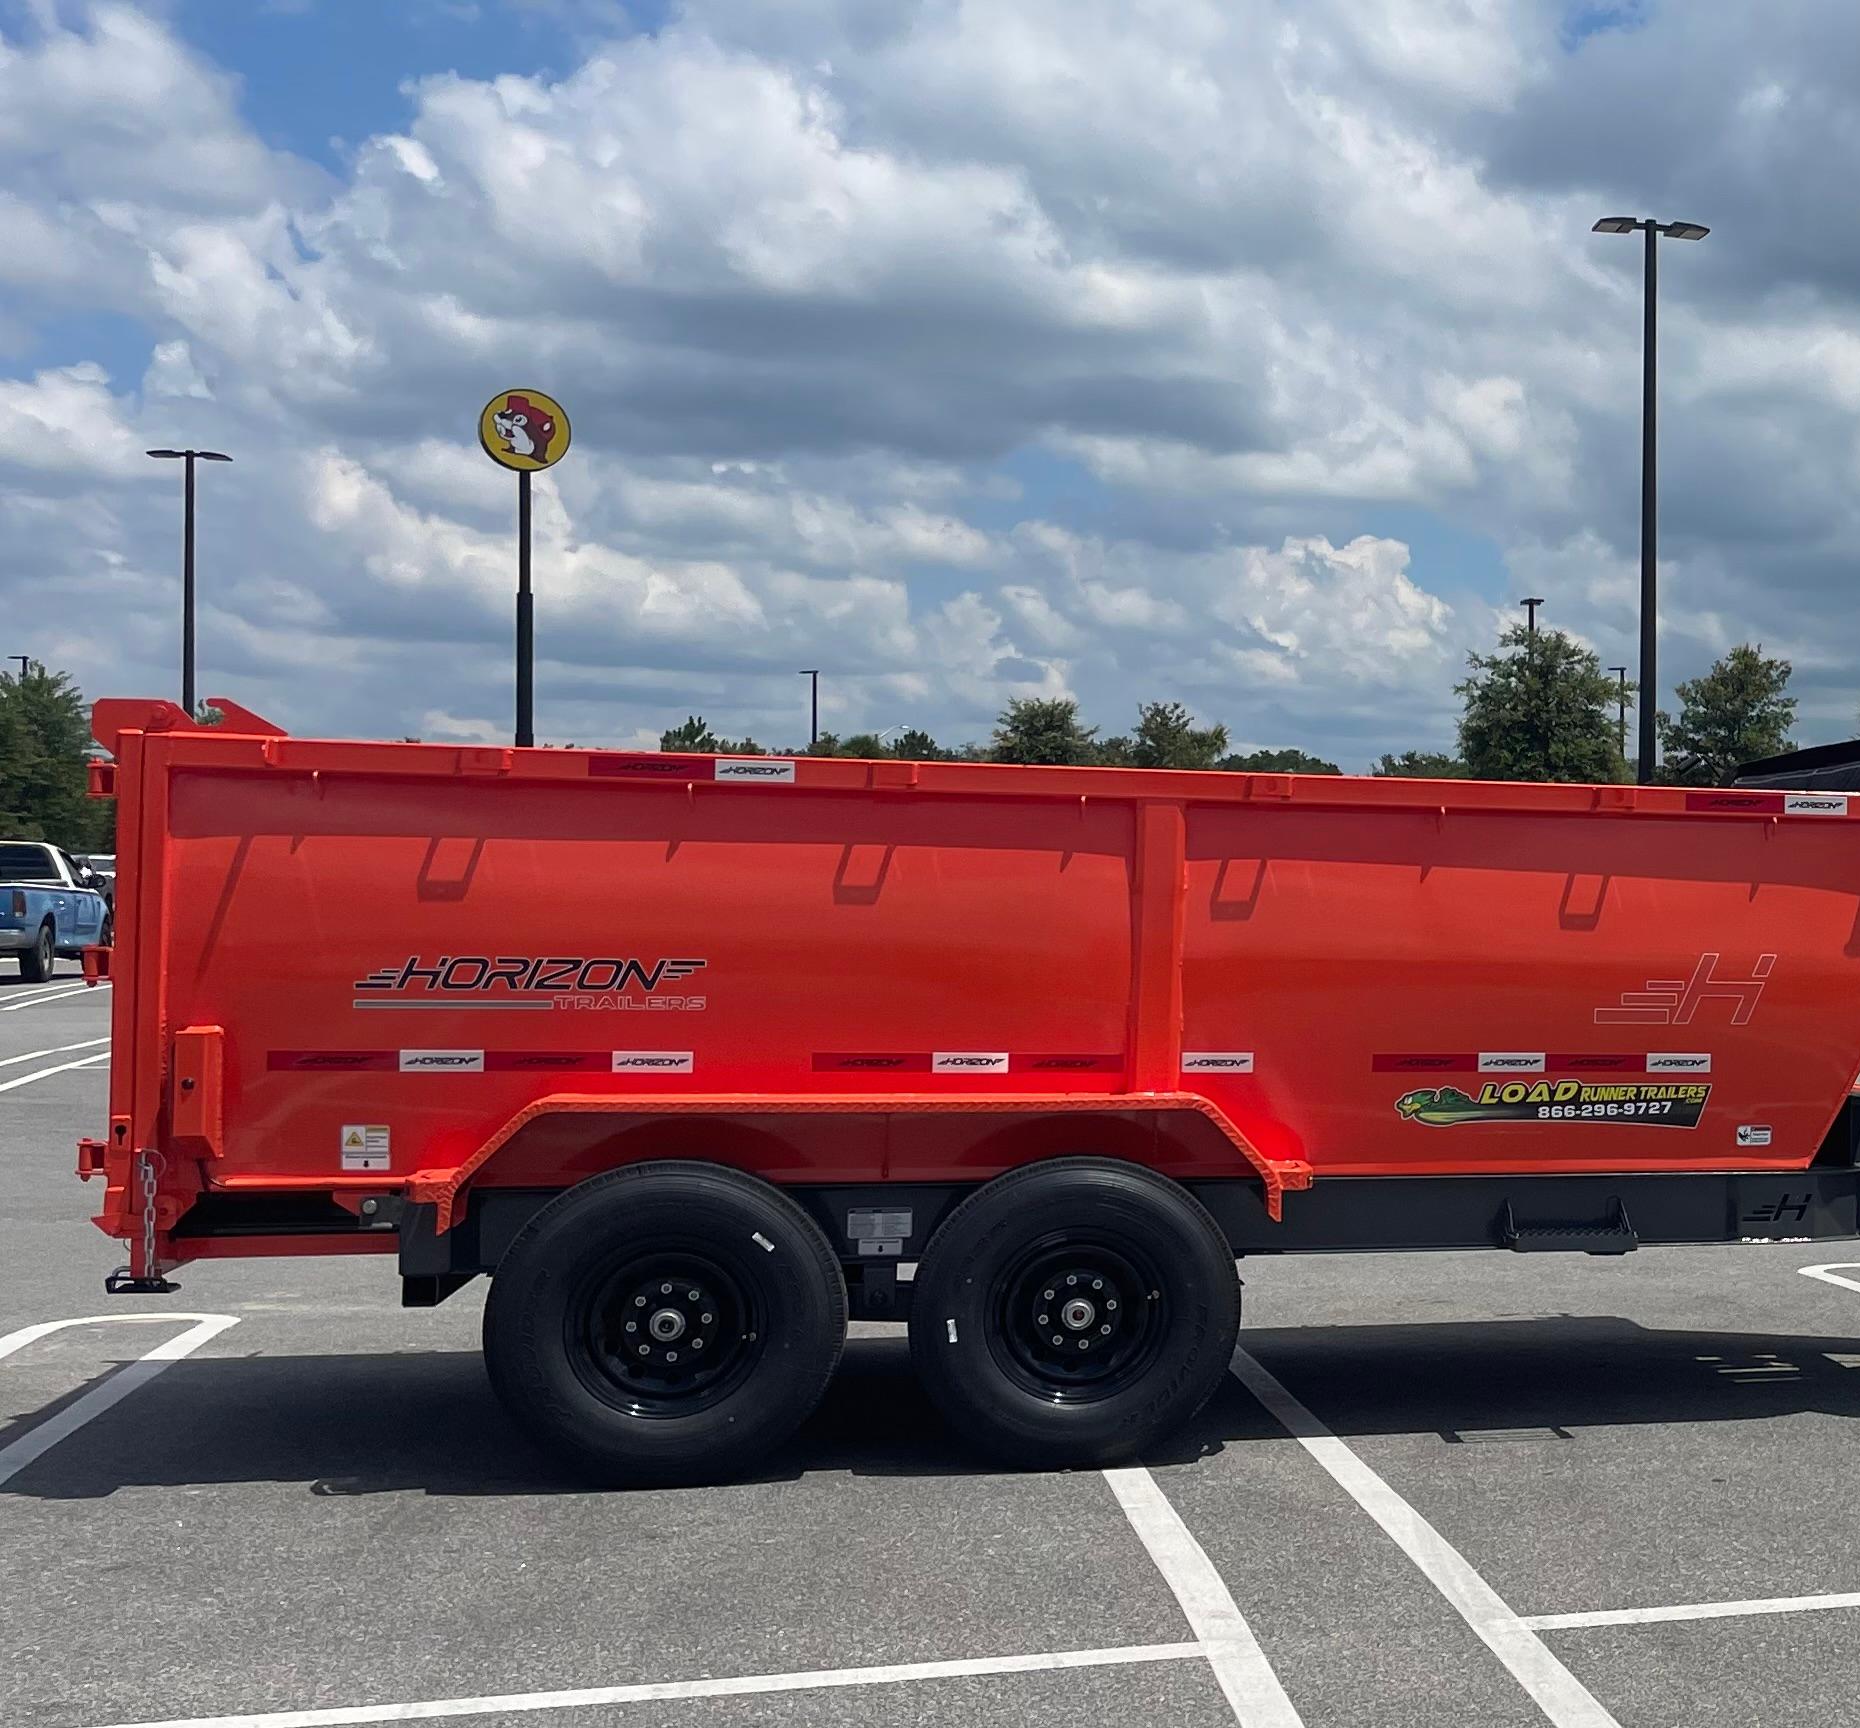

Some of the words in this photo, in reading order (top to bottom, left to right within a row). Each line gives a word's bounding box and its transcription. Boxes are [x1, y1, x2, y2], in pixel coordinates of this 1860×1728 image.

[727, 766, 784, 776] HORIZON
[398, 956, 667, 991] HORIZON
[554, 996, 706, 1011] TRAILERS
[624, 1058, 682, 1067] HORIZON
[946, 1057, 998, 1066] HORIZON
[1480, 1081, 1579, 1104] LOAD
[1580, 1086, 1636, 1102] RUNNER
[1640, 1086, 1706, 1100] TRAILERS
[1537, 1102, 1672, 1119] 866-296-9727
